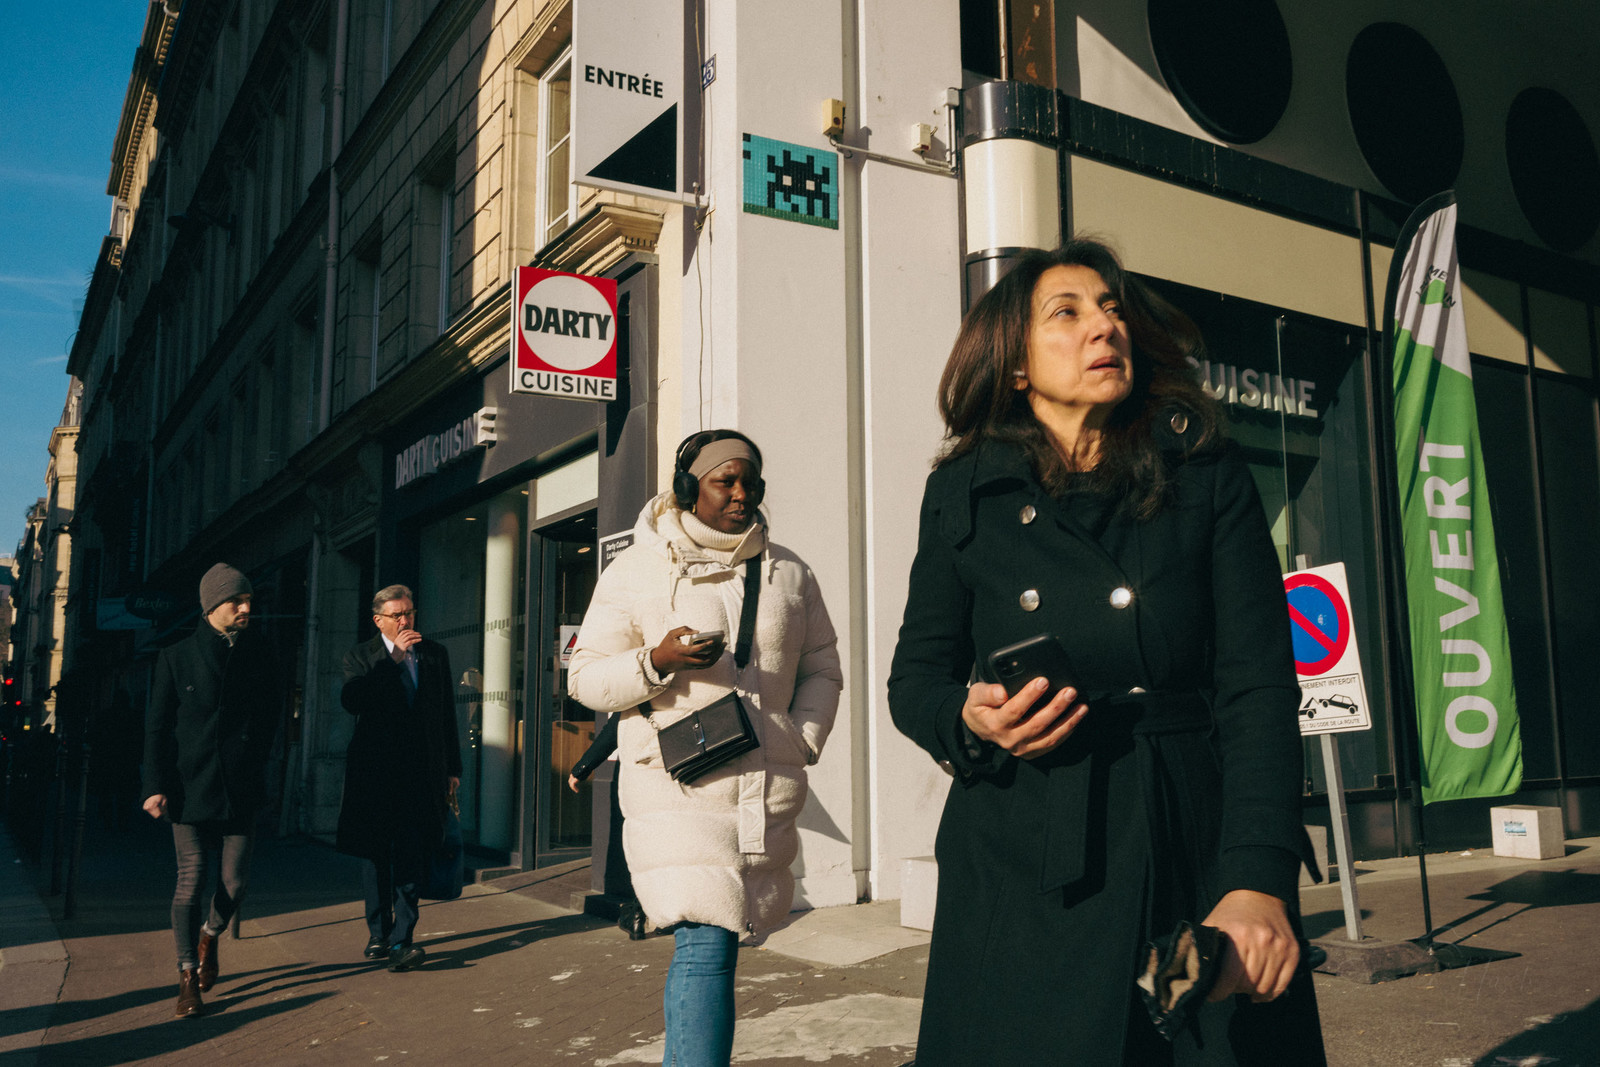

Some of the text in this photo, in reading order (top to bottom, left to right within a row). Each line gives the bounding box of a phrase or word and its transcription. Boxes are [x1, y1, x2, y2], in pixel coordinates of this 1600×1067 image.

[585, 64, 663, 98] ENTRÉE
[525, 303, 612, 341] DARTY
[521, 371, 613, 397] CUISINE
[1186, 356, 1318, 418] UISINE
[395, 406, 498, 490] DARTY CUISINE
[1418, 427, 1499, 749] OUVERT
[1328, 677, 1356, 686] INTERDIT
